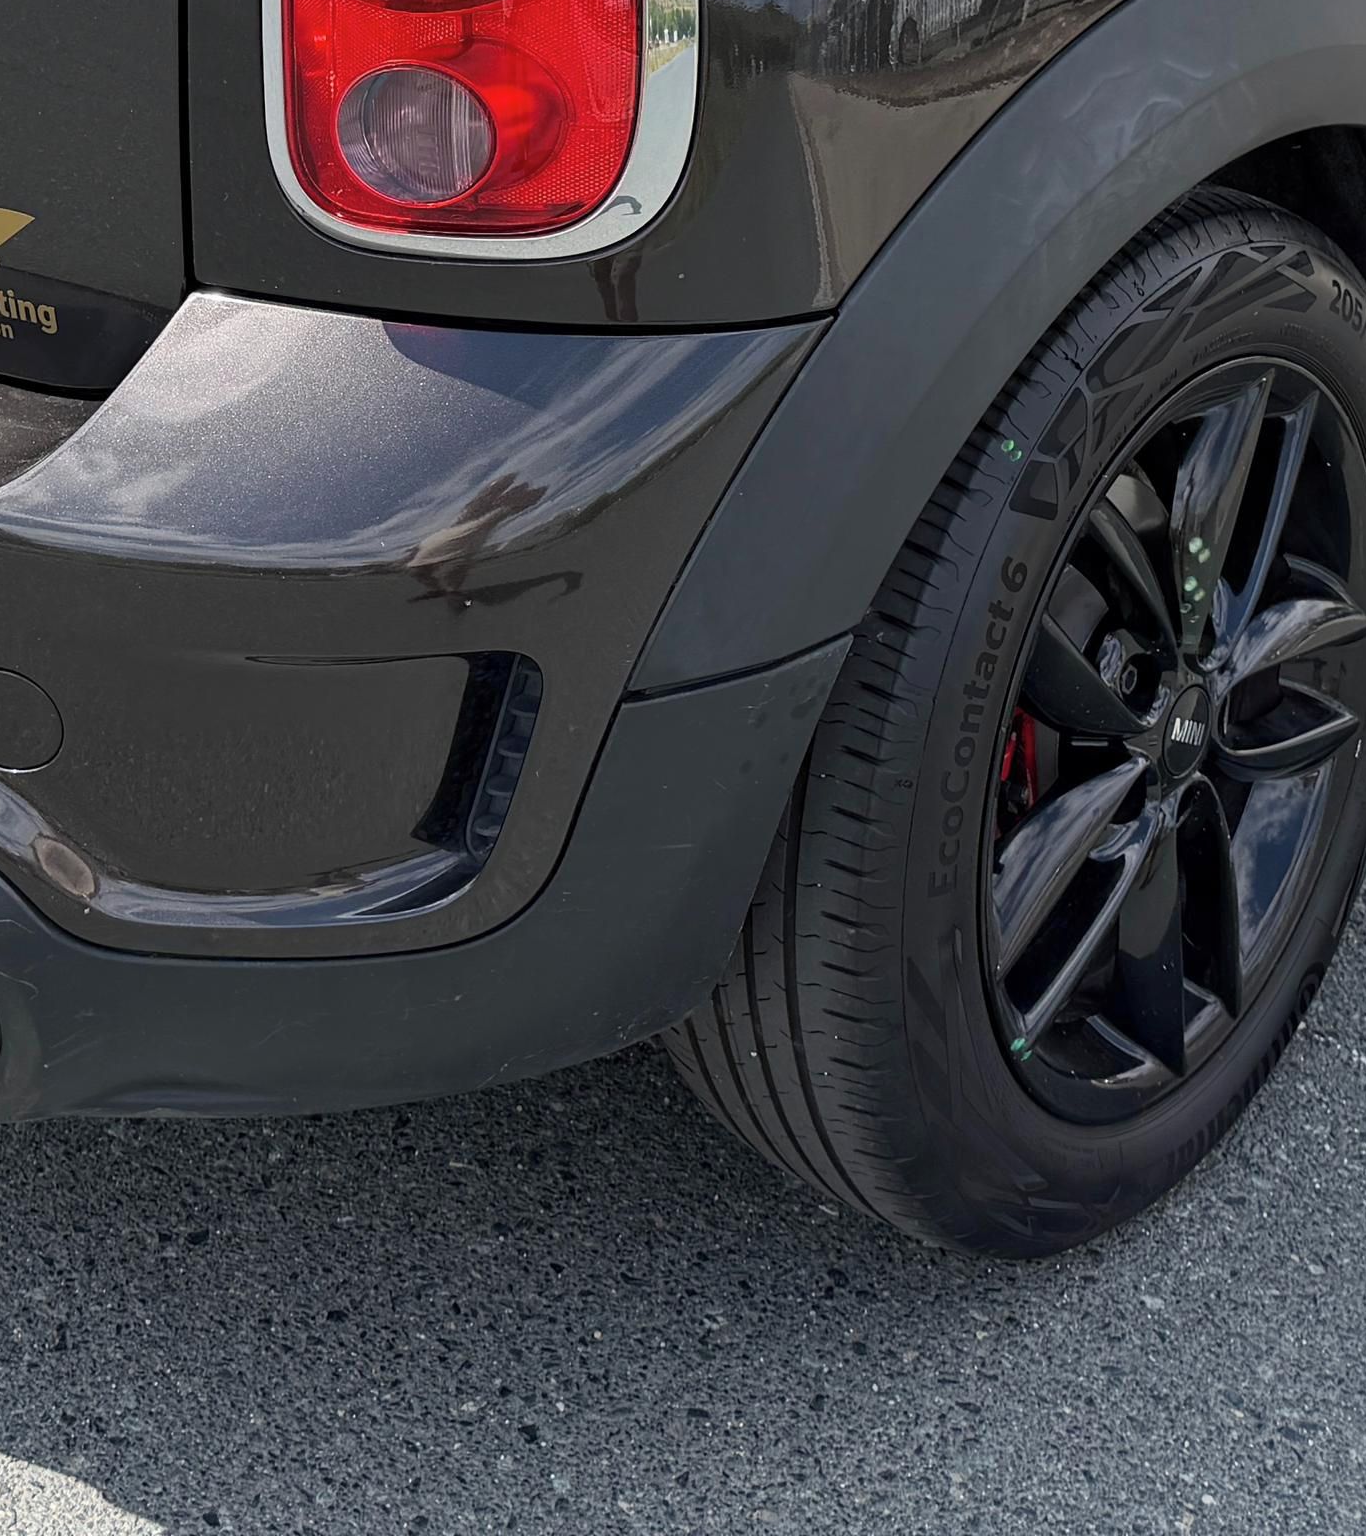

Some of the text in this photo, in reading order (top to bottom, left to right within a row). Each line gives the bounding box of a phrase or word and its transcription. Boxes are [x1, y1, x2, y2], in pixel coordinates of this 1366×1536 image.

[928, 555, 1028, 898] EcoContact 6
[1171, 717, 1206, 746] MINI
